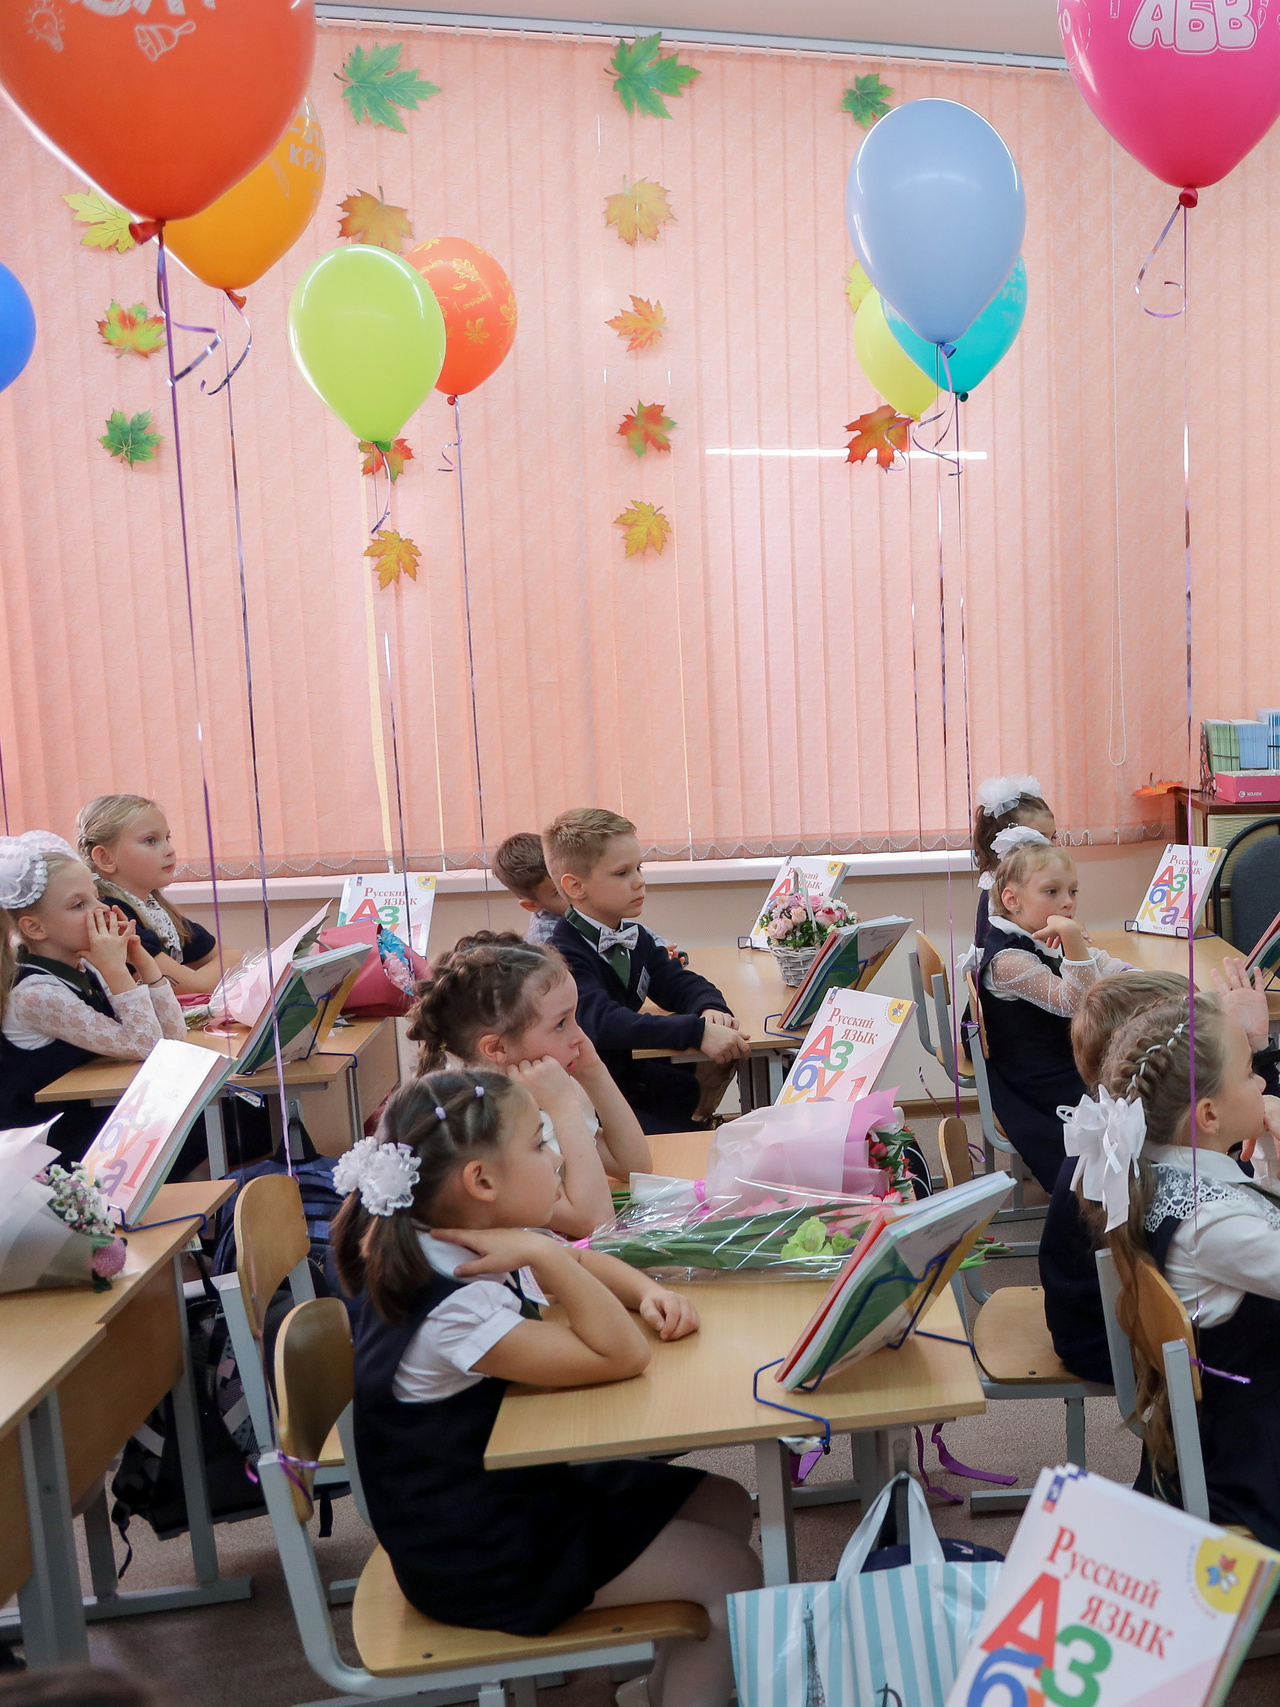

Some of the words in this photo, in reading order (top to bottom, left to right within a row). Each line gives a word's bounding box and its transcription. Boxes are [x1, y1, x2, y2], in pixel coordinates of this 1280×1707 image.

[1128, 0, 1257, 54] АБВ
[289, 143, 325, 172] КРУ
[364, 887, 408, 899] Русски
[828, 1007, 875, 1029] Русский
[123, 1137, 160, 1189] 1
[1045, 1524, 1161, 1611] Русский
